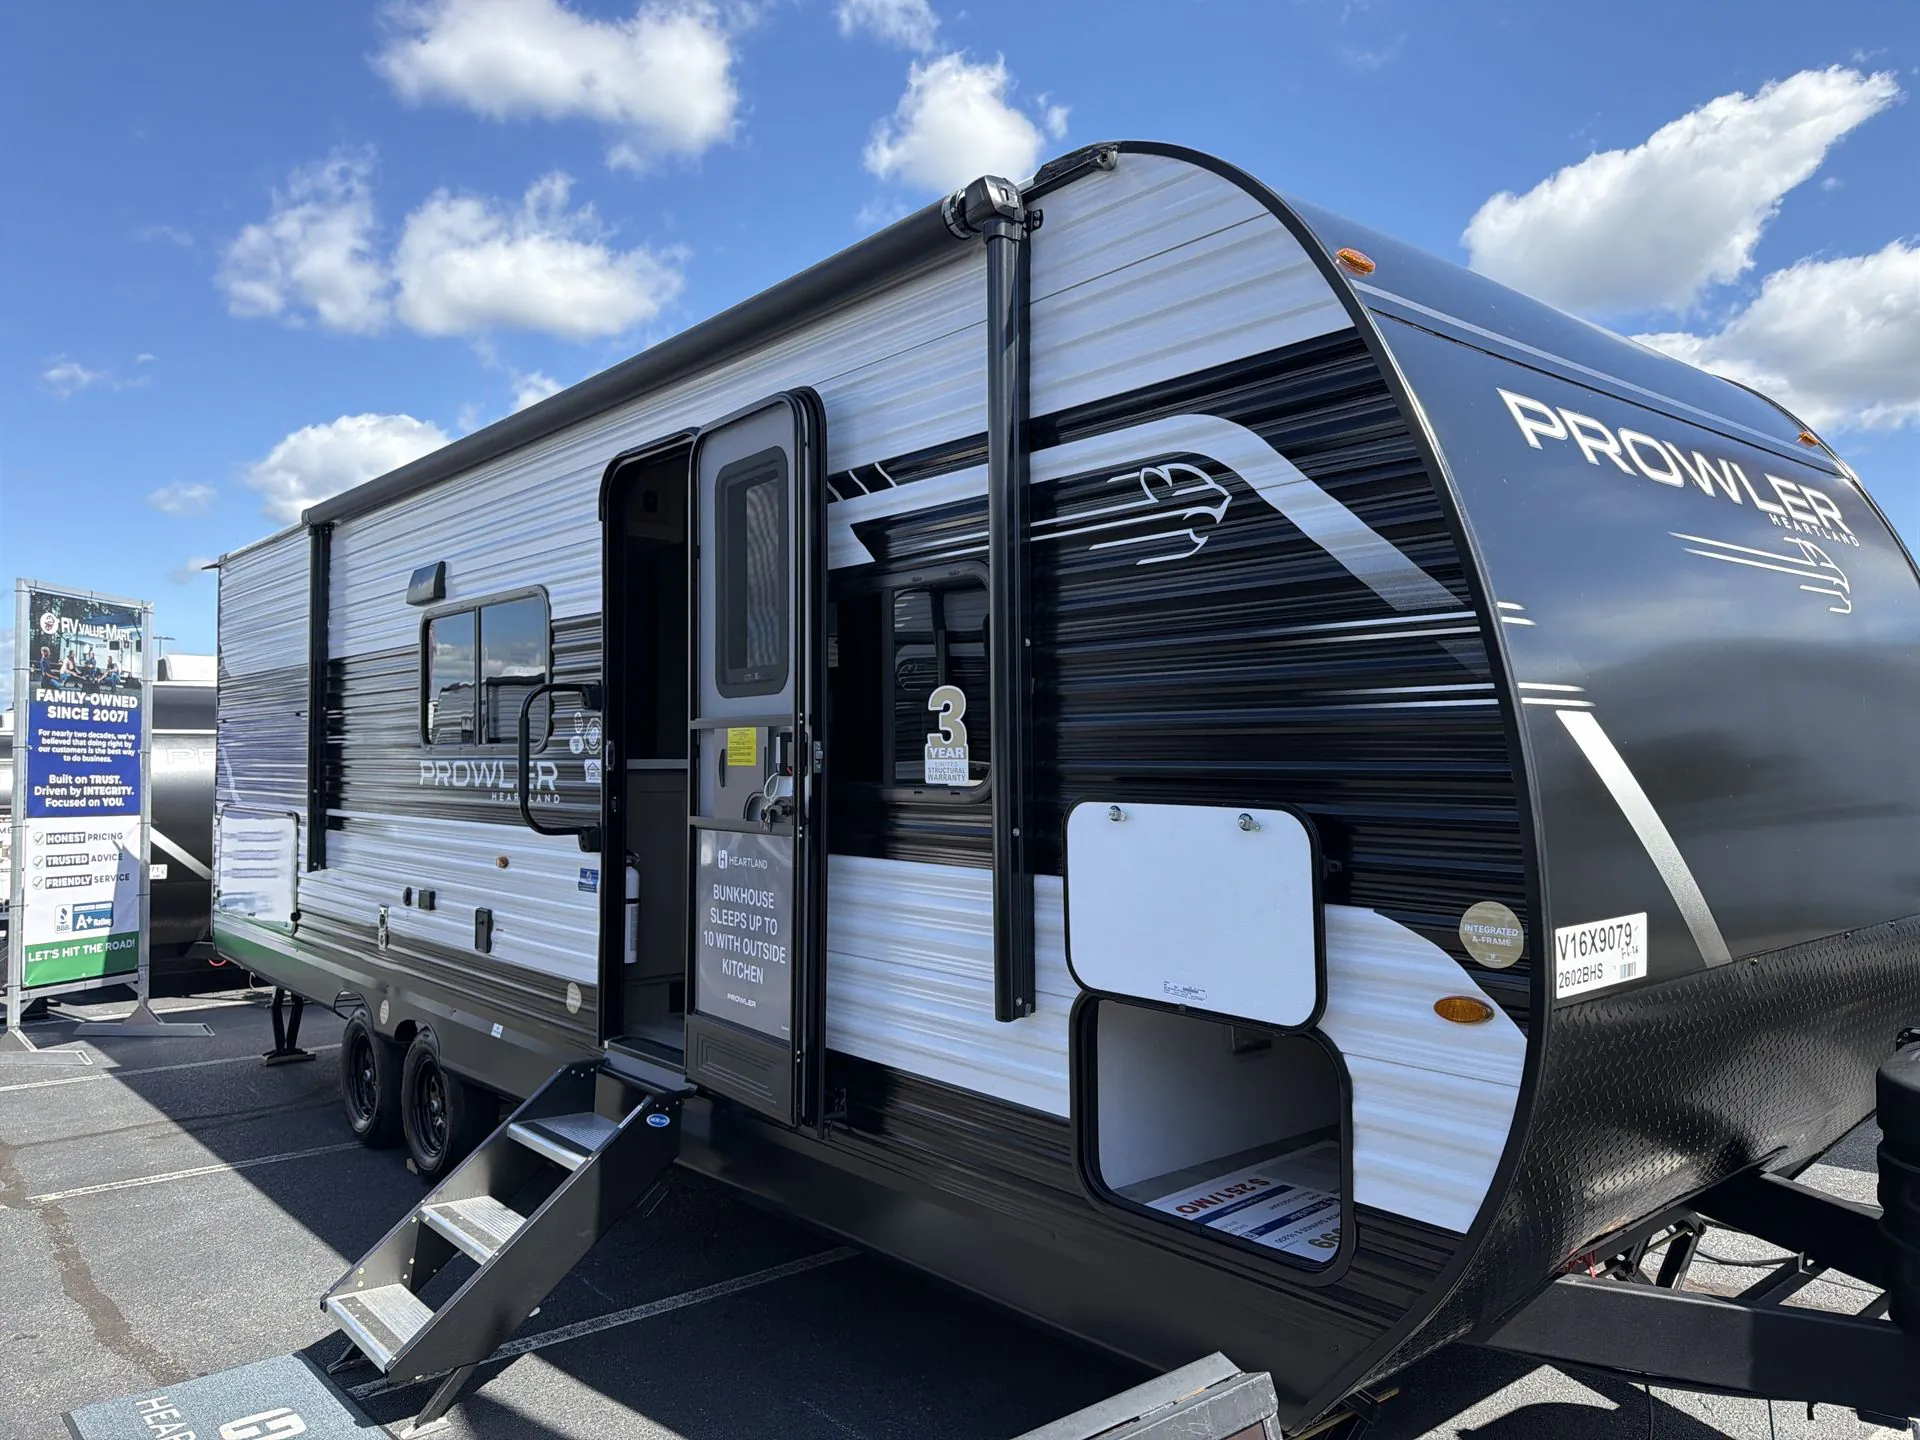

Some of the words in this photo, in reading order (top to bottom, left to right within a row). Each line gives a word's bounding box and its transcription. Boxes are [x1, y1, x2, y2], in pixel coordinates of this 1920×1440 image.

[1496, 387, 1855, 537] PROWLER
[1769, 513, 1860, 548] HEARTLAND
[61, 617, 78, 633] RV
[36, 689, 137, 708] FAMILY-OWNED
[48, 706, 89, 720] SINCE
[93, 709, 128, 723] 2007!
[928, 686, 967, 746] 3
[52, 730, 73, 738] nearly
[88, 739, 106, 748] doing
[108, 740, 123, 748] right
[929, 747, 964, 758] YEAR
[49, 774, 73, 784] Built
[89, 775, 122, 784] TRUST.
[34, 786, 67, 796] Driven
[70, 787, 81, 797] by
[84, 786, 134, 795] INTEGRITY.
[492, 792, 560, 803] HEARLAND
[45, 798, 86, 808] Focused
[88, 799, 100, 807] on
[102, 798, 124, 807] YOU.
[47, 833, 85, 844] HONEST
[87, 832, 123, 841] PRICING
[46, 855, 88, 866] TRUSTED
[91, 853, 123, 862] ADVICE
[728, 856, 768, 870] HEARTLAND
[46, 875, 91, 888] FRIENDLY
[94, 873, 130, 883] SERVICE
[713, 884, 774, 909] BUNKHOUSE
[76, 914, 93, 929] A+
[710, 907, 747, 929] SLEEPS
[749, 915, 762, 932] UP
[764, 917, 778, 936] TO
[1464, 924, 1518, 936] INTEGRATED
[704, 930, 714, 946] 10
[716, 933, 741, 952] WITH
[743, 938, 786, 964] OUTSIDE
[1472, 936, 1512, 946] A-FRAME
[1558, 922, 1632, 960] V16X9079
[28, 948, 59, 962] LET'S
[62, 946, 80, 958] HIT
[82, 943, 103, 954] THE
[105, 938, 135, 952] ROAD!
[722, 958, 764, 984] KITCHEN
[1559, 963, 1603, 989] 2602BHS
[727, 993, 756, 1008] PROWLER
